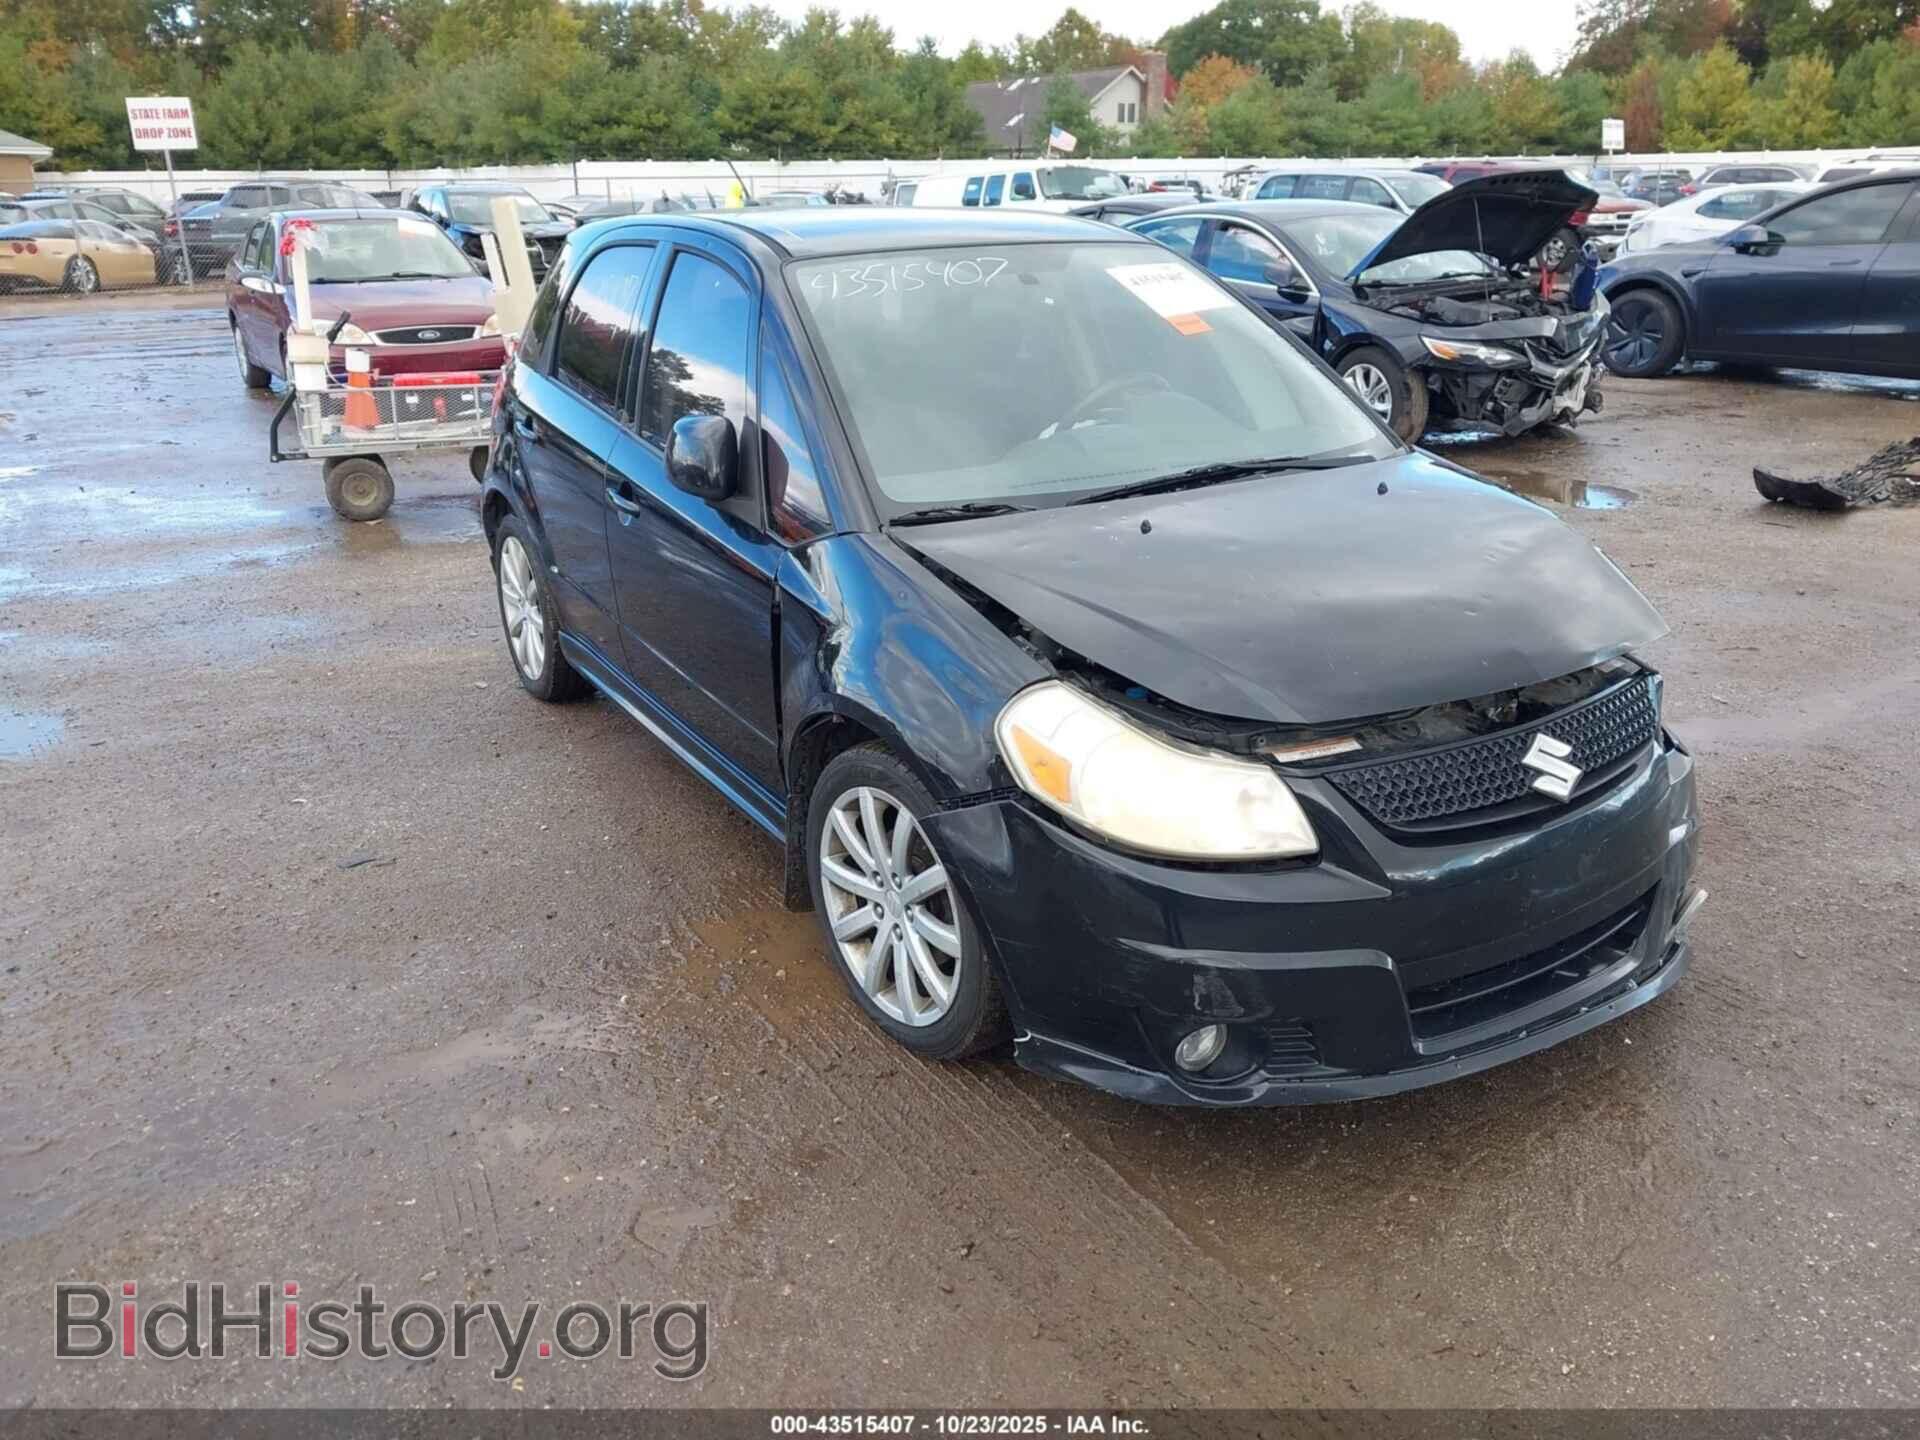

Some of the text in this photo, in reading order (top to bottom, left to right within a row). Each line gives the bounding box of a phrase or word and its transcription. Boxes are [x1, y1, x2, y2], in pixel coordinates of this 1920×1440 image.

[130, 108, 190, 120] STATE FARM
[134, 127, 193, 139] DROP ZONE
[810, 256, 1009, 300] 43515407
